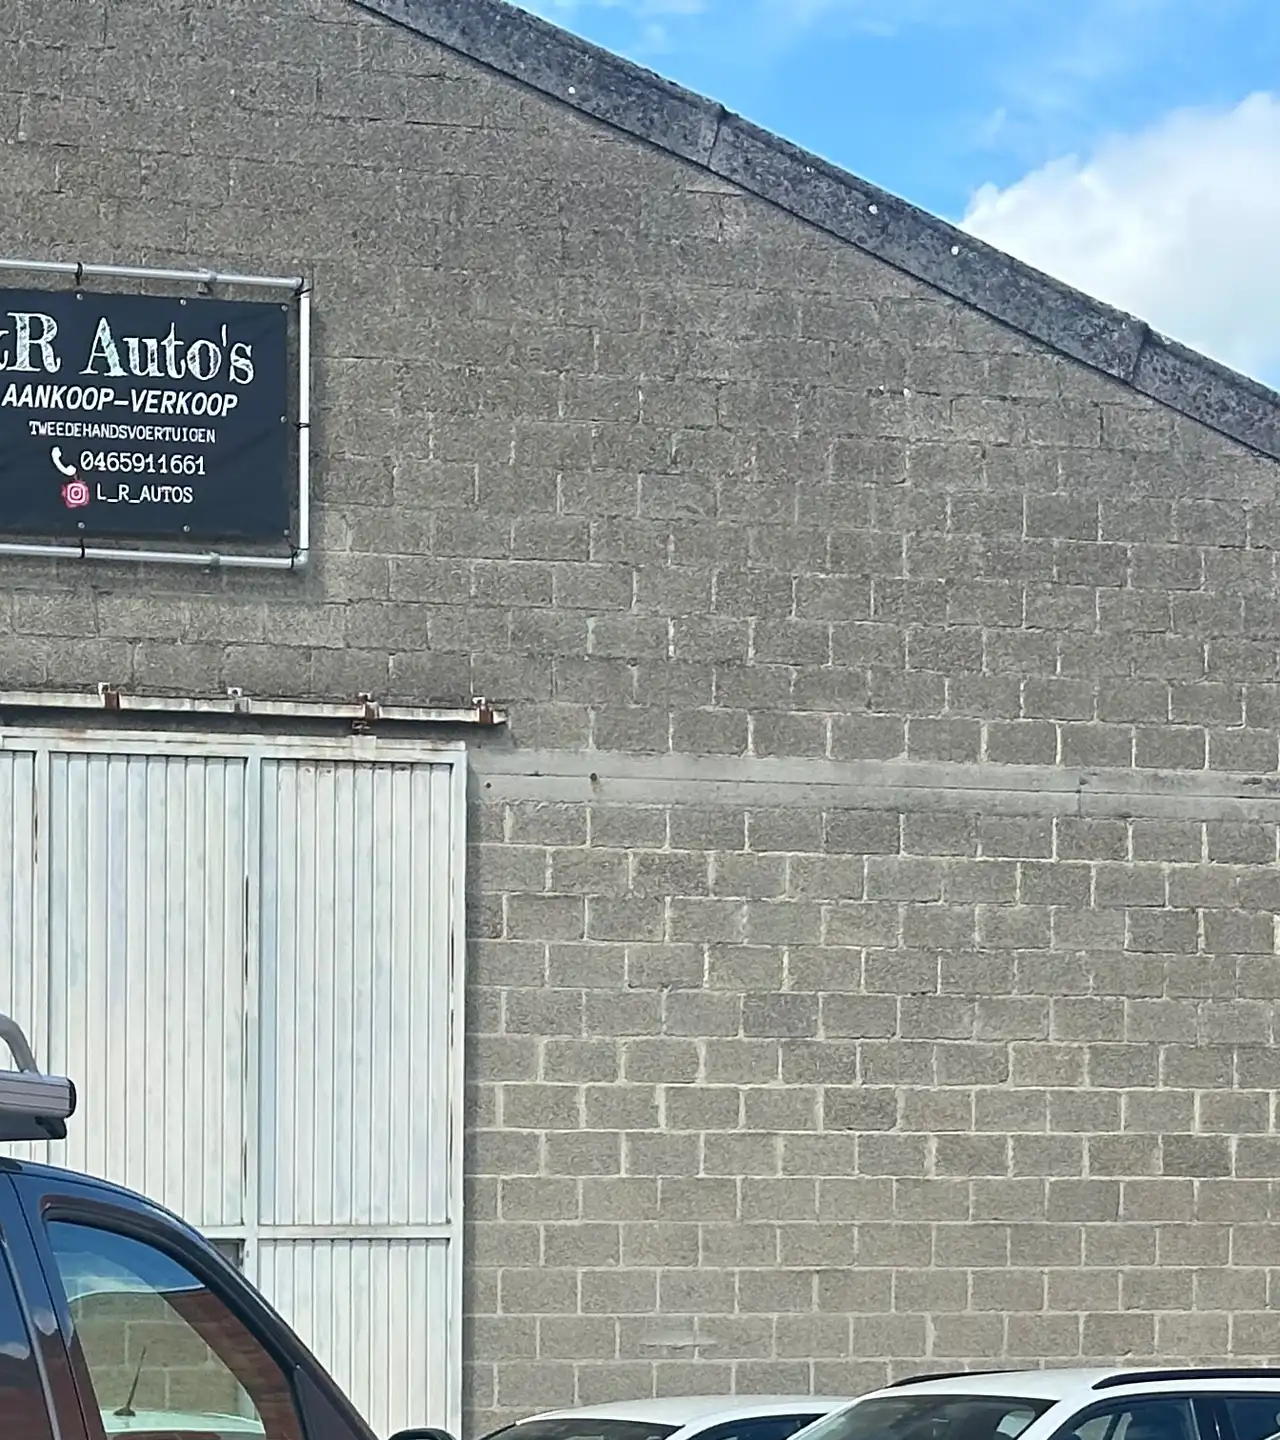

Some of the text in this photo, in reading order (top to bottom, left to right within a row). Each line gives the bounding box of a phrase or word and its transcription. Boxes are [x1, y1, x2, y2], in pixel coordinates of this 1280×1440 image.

[79, 316, 255, 385] Auto's
[1, 383, 238, 417] AANKOOP-VERKOOP
[28, 420, 216, 444] TWEEDEHANDSVOERTUIGEN
[80, 450, 206, 475] 0465911661
[96, 482, 194, 504] L_R_AUTOS
